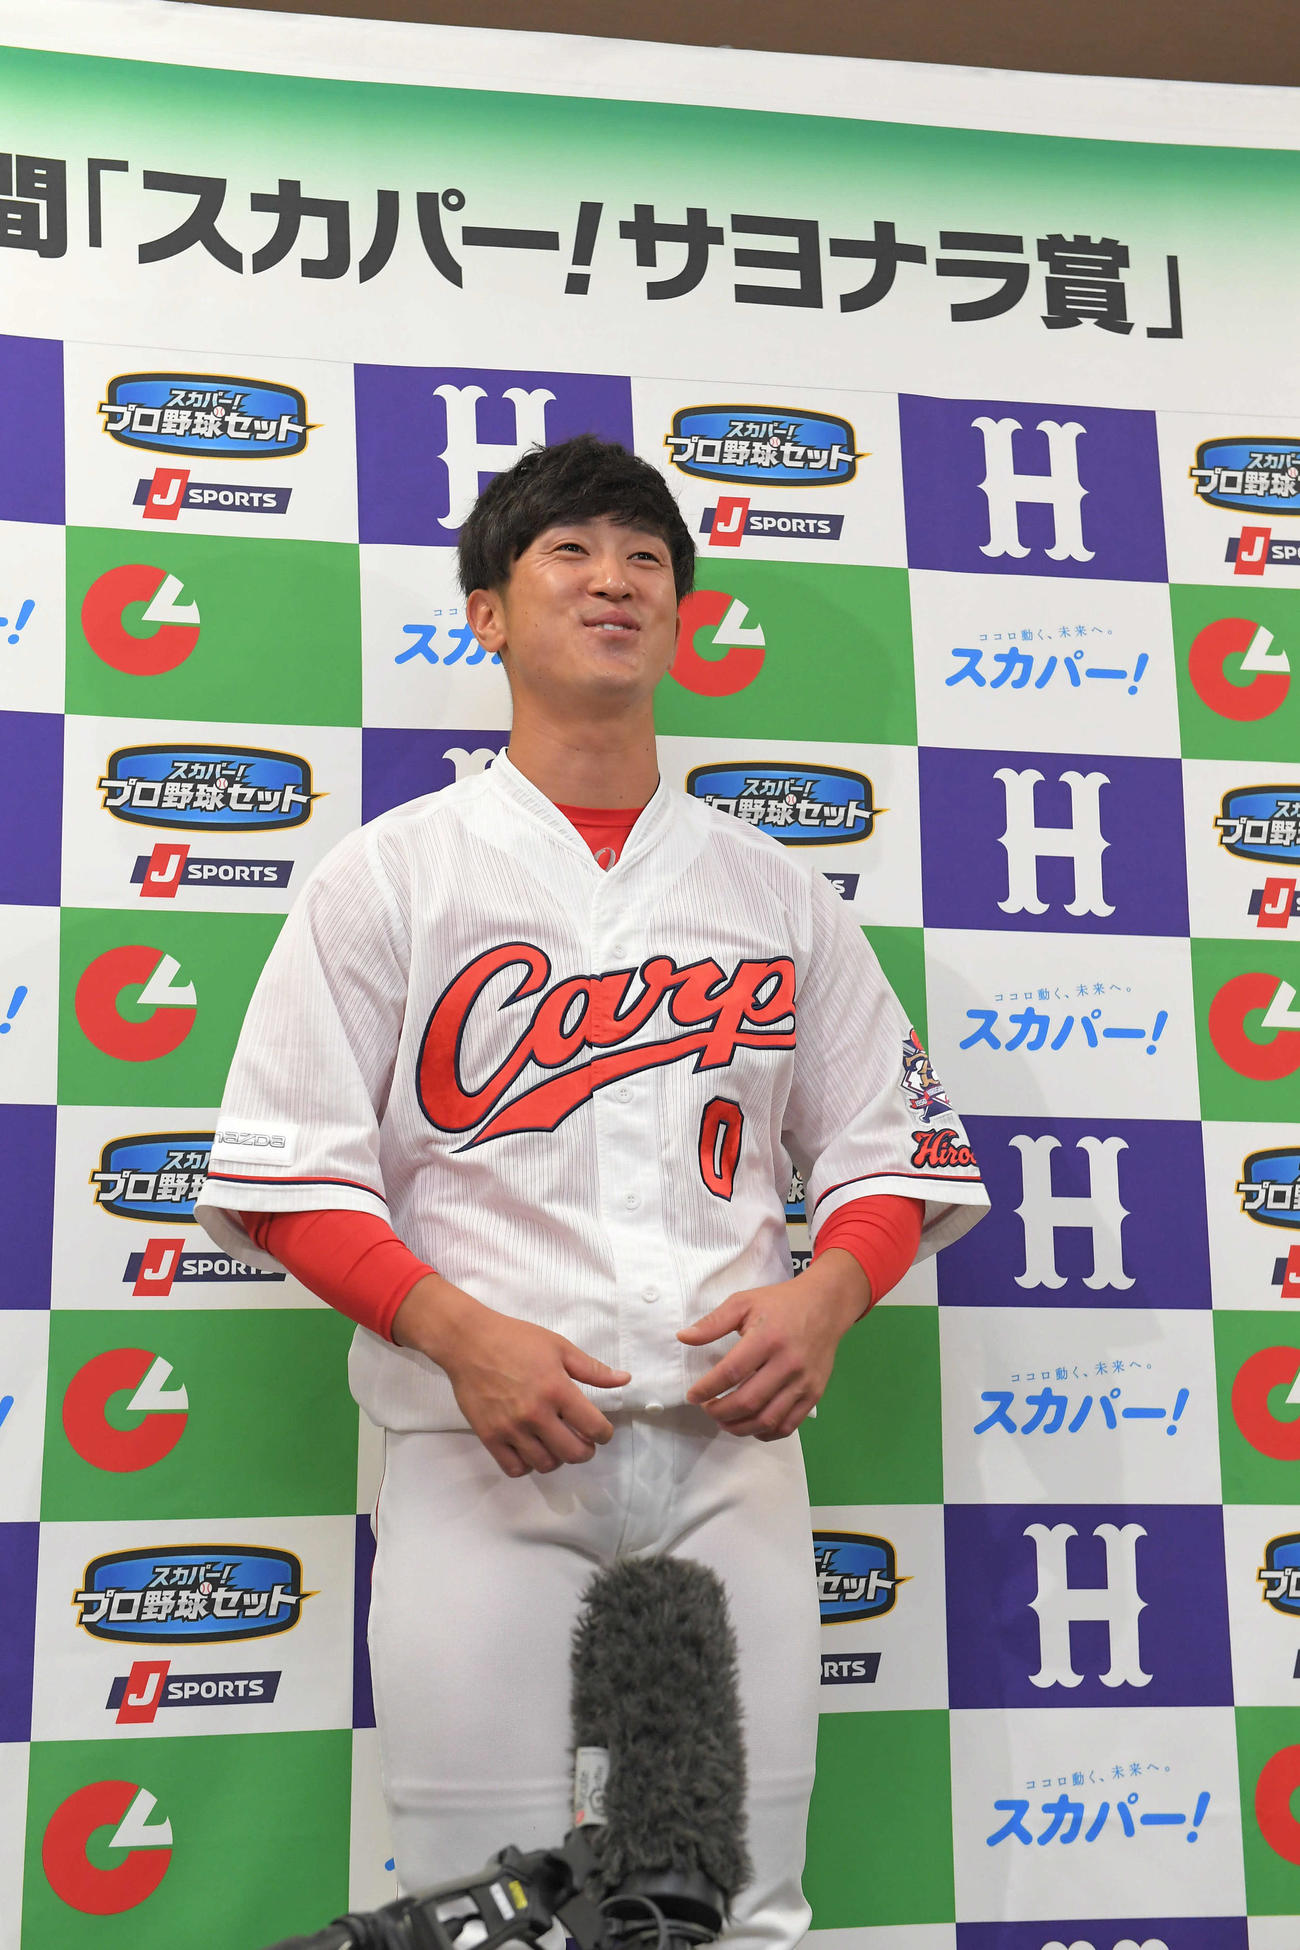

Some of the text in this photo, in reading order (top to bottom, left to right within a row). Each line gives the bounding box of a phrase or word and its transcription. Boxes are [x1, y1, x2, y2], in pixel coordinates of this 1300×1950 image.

[166, 389, 243, 410] スカパー!
[100, 404, 307, 442] プロ野球セット
[726, 421, 797, 440] スカパー!
[666, 436, 856, 471] プロ野球セット
[152, 478, 278, 508] J SPORTS
[970, 416, 1097, 562] H
[1191, 467, 1300, 498] プロ野球
[716, 506, 832, 534] J SPORTS
[1240, 536, 1265, 562] J
[945, 646, 1150, 696] スカパー!
[169, 761, 247, 780] スカパー!
[742, 778, 814, 797] スカパー!
[100, 778, 311, 813] プロ野球セット
[993, 767, 1117, 918] H
[150, 853, 278, 883] J SPORTS
[415, 941, 797, 1154] Carp
[959, 1006, 1169, 1056] スカパー!
[698, 1095, 745, 1202] 0
[1008, 1134, 1137, 1292] H
[143, 1249, 176, 1281] J
[973, 1386, 1190, 1437] スカパー!
[150, 1565, 231, 1587] スカパー!
[76, 1584, 302, 1623] プロ野球セット
[1022, 1523, 1153, 1688] H
[821, 1660, 867, 1678] RTS
[127, 1672, 264, 1707] J SPORTS
[986, 1791, 1211, 1847] スカパー!
